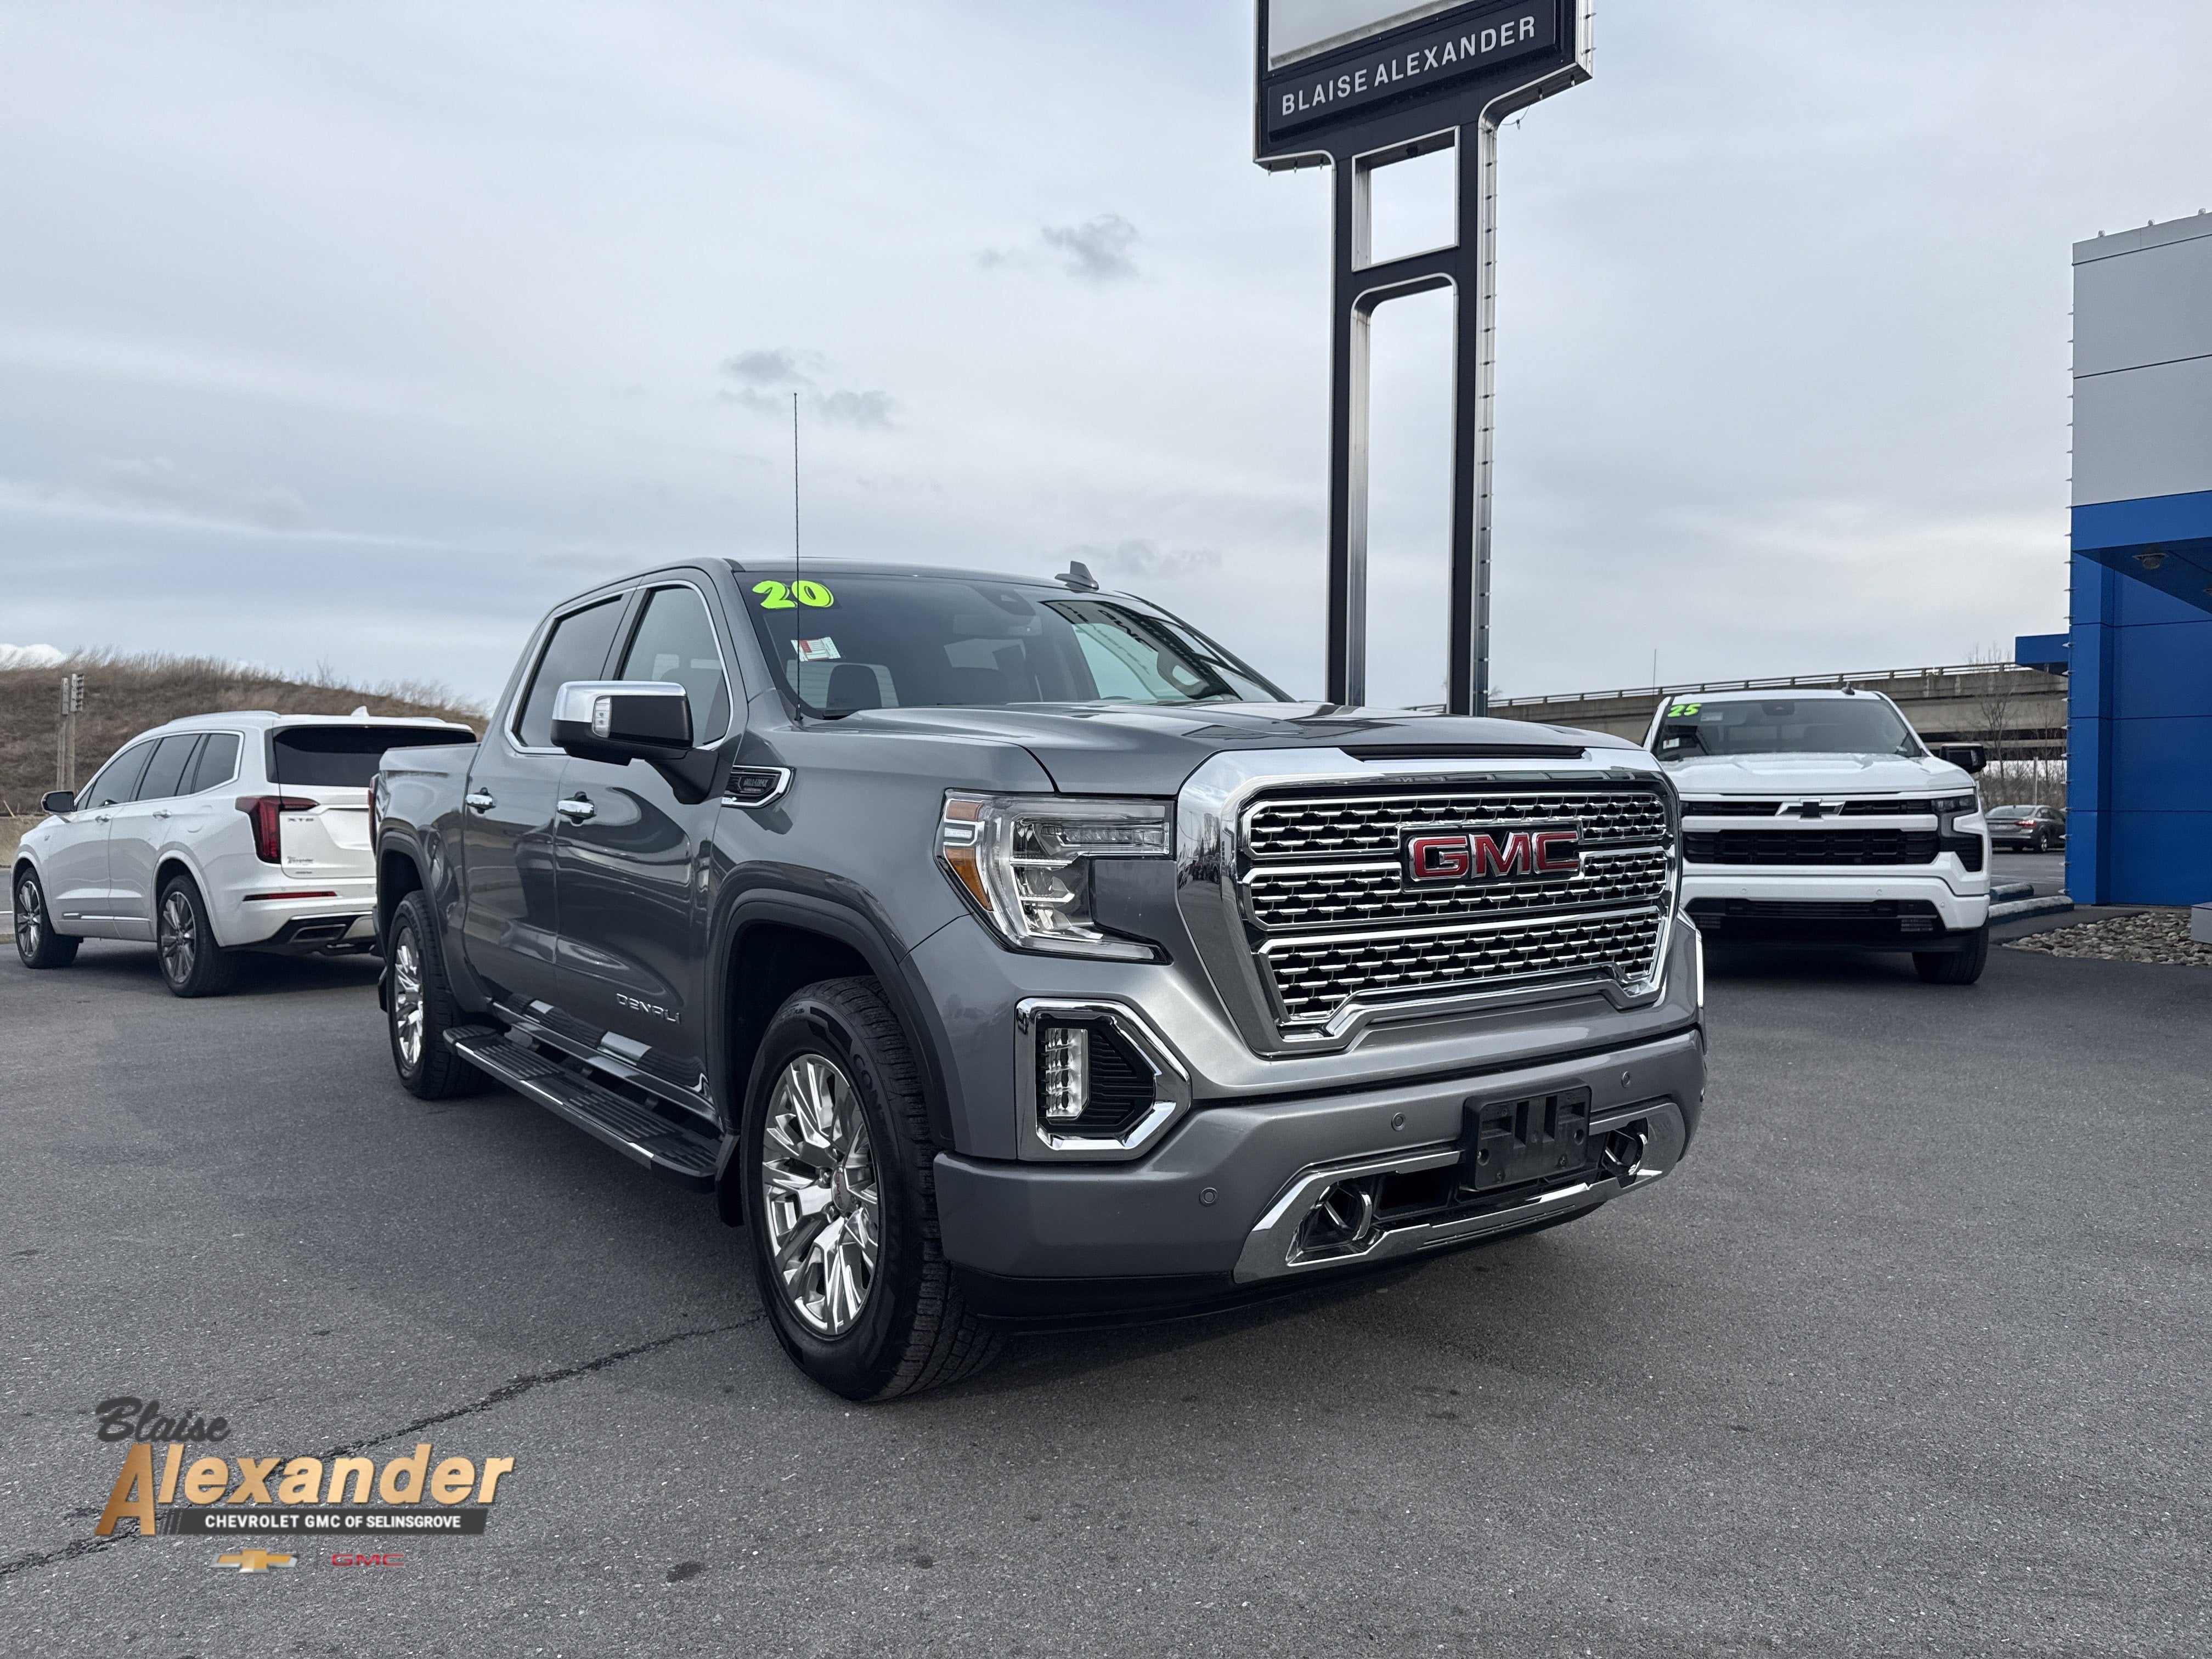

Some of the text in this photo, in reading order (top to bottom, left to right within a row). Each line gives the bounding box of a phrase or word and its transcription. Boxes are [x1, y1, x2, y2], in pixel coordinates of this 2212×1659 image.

[1282, 16, 1535, 116] BLAISE ALEXANDER
[752, 580, 834, 609] 20
[1667, 703, 1702, 718] 25
[1408, 831, 1579, 882] GMC
[616, 993, 681, 1025] DENALI
